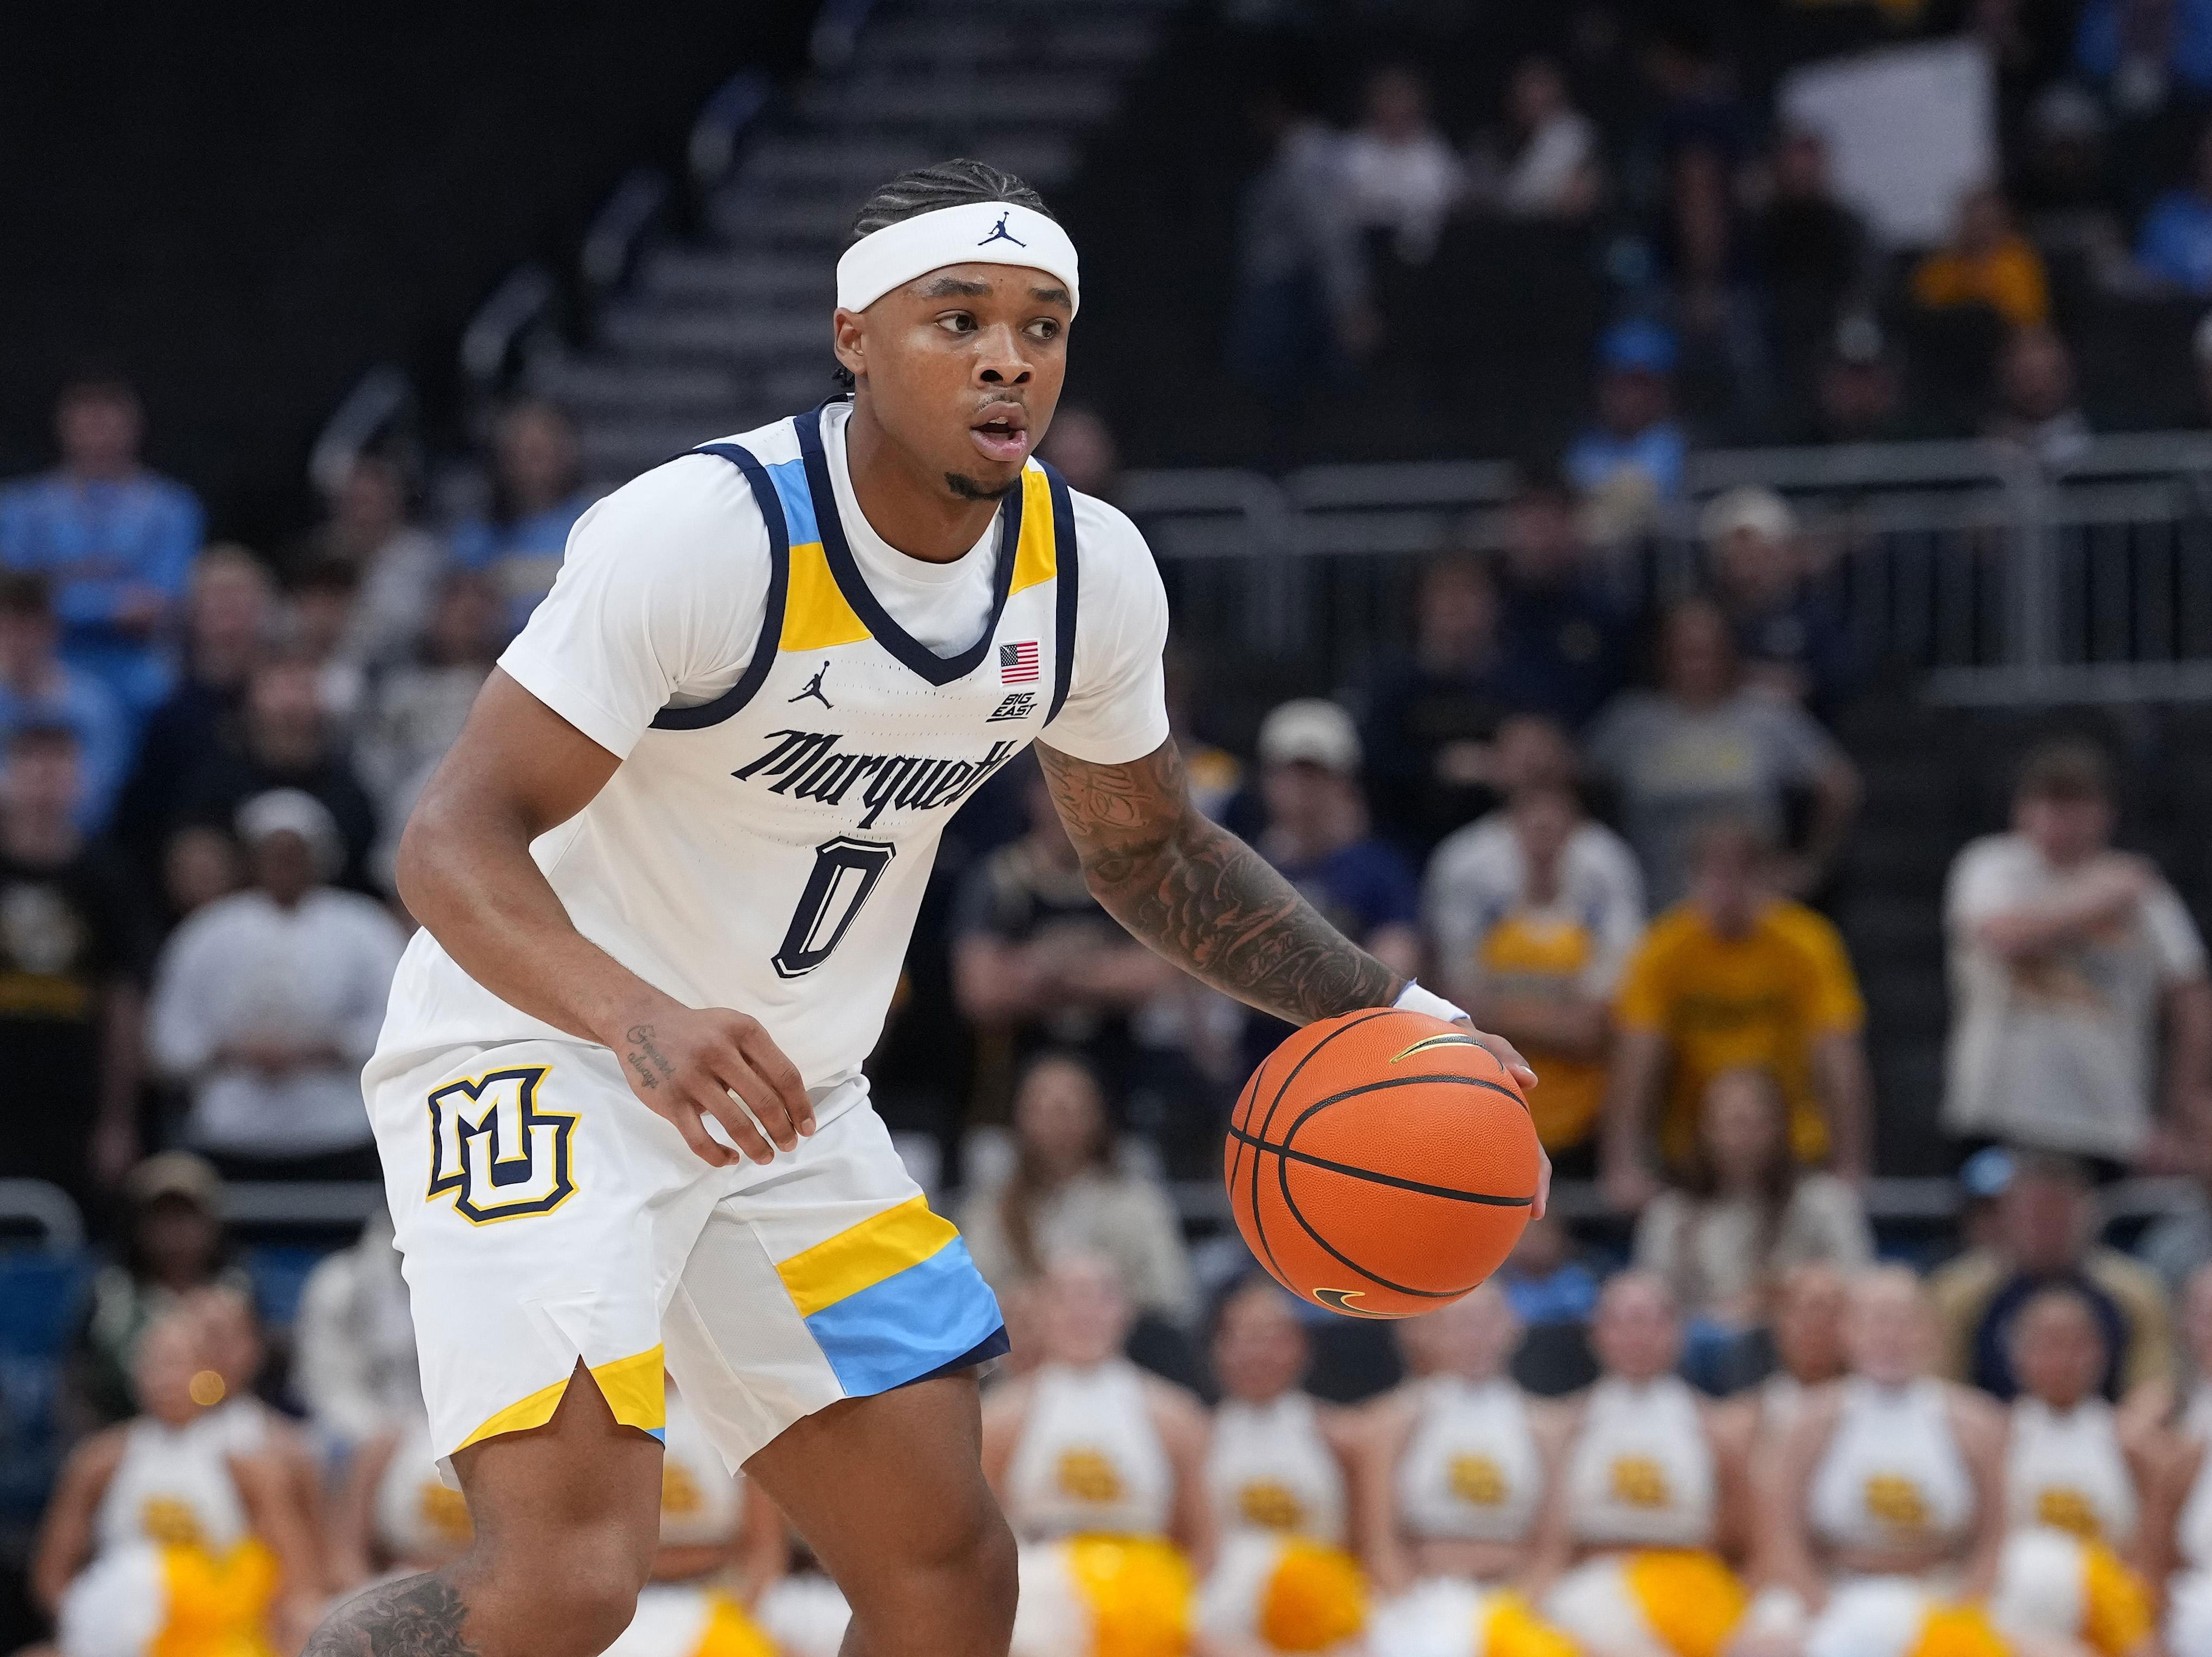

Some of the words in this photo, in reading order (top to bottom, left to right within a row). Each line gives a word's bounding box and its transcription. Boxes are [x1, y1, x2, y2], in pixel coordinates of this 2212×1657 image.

[991, 703, 1038, 717] EAST
[1002, 692, 1035, 705] BIG
[731, 730, 1018, 829] Marquett
[771, 835, 896, 979] 0
[426, 1065, 582, 1227] MU
